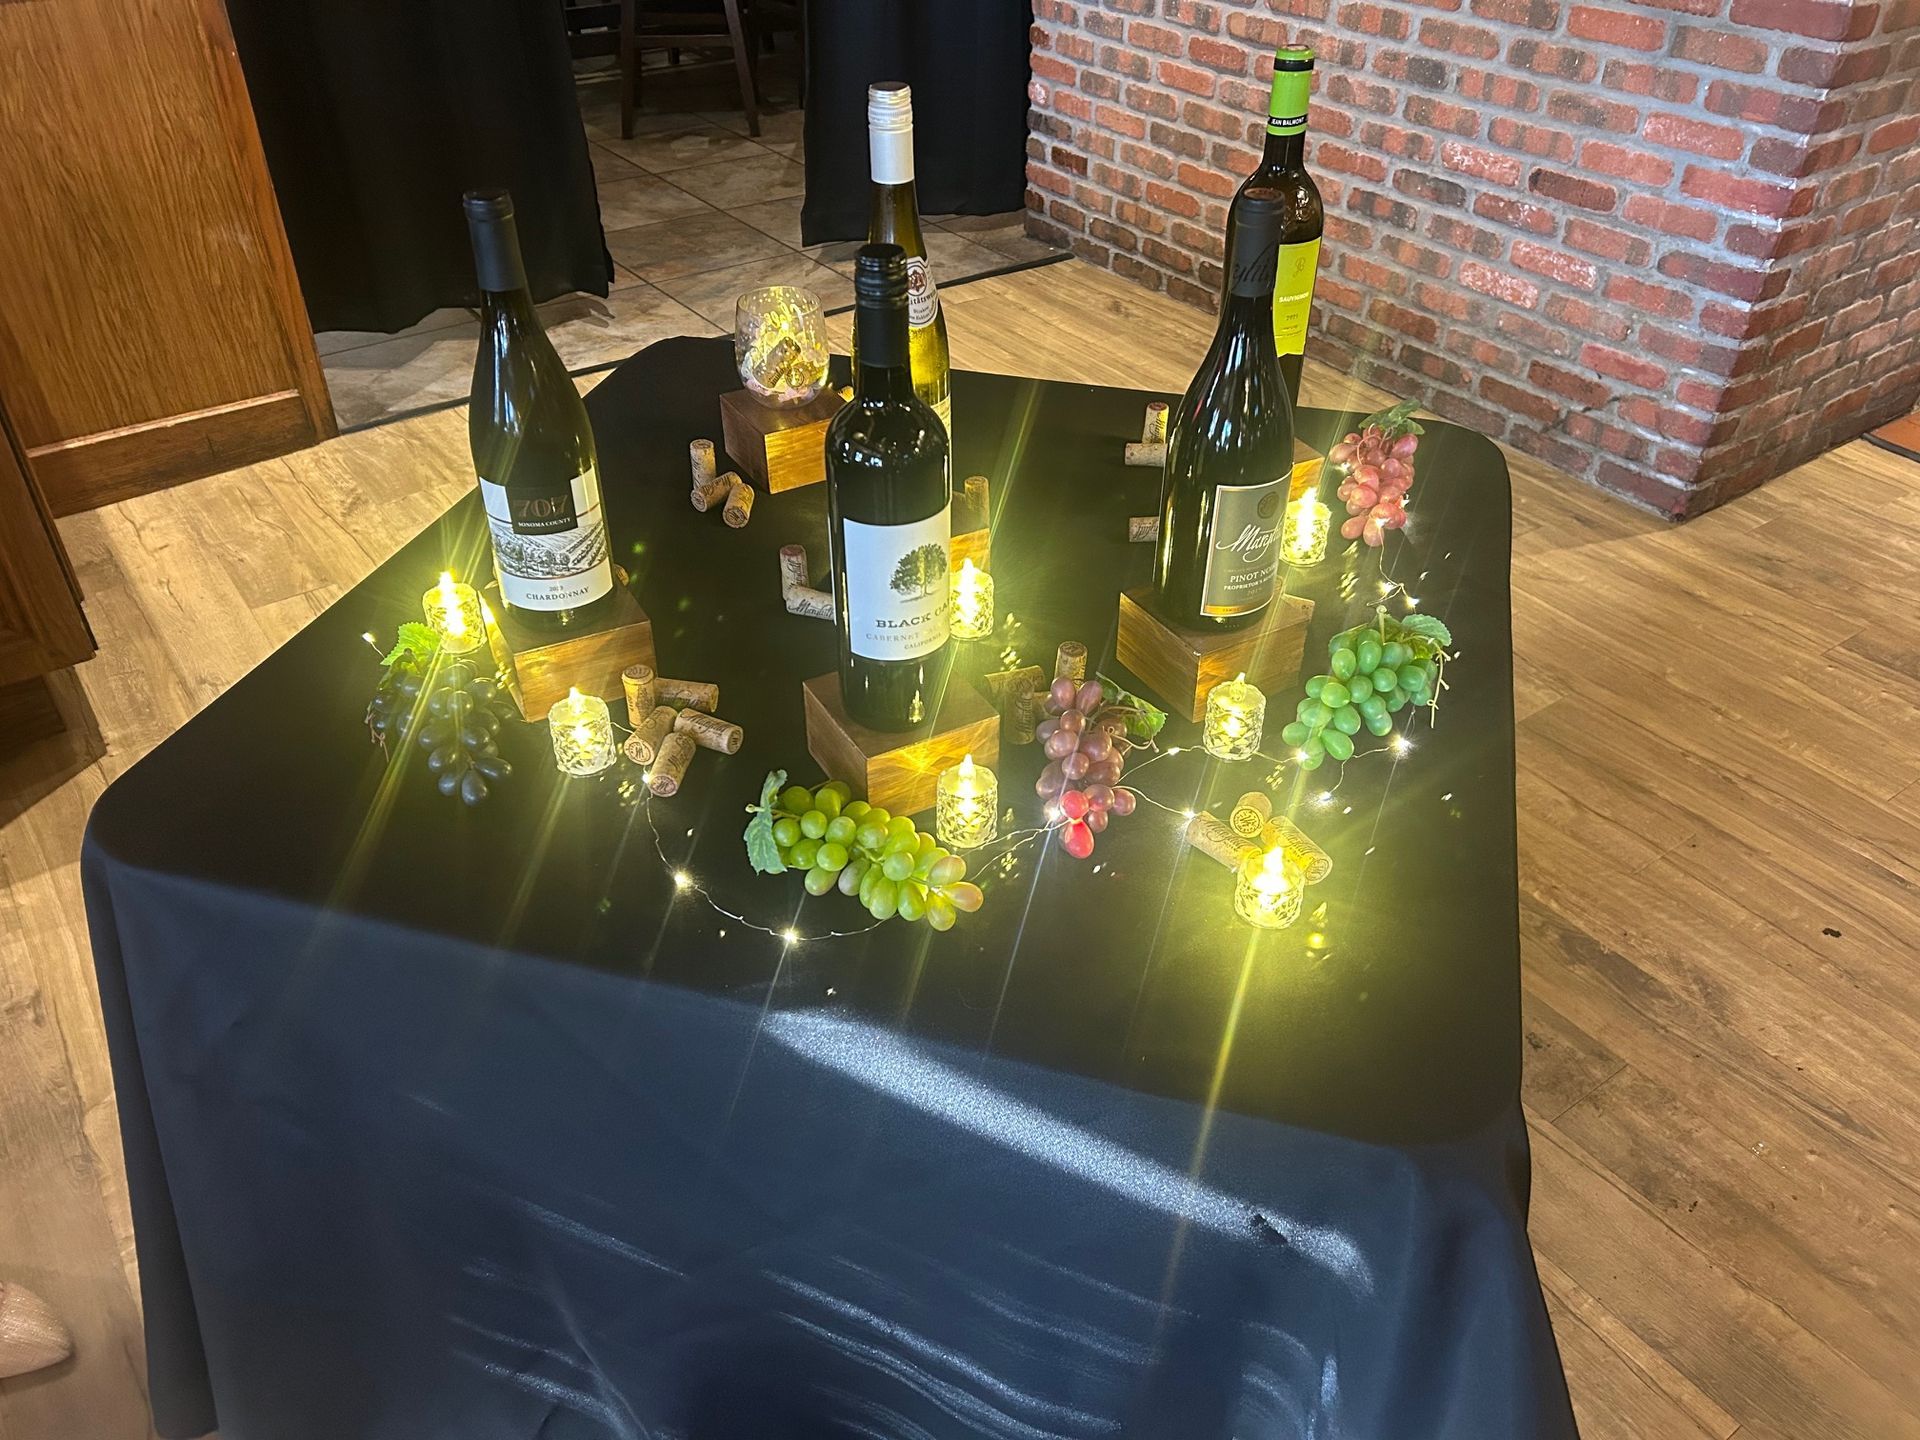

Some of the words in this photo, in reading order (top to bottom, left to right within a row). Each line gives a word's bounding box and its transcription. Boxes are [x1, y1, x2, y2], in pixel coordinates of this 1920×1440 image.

[1271, 118, 1282, 126] JEAN
[1283, 116, 1305, 126] BALMONT
[513, 494, 569, 518] 707
[545, 517, 571, 527] COUNTY
[1230, 571, 1260, 583] PINOT
[526, 586, 590, 601] CHARDONNAY
[875, 613, 932, 629] BLACK
[865, 632, 920, 642] CABERNET
